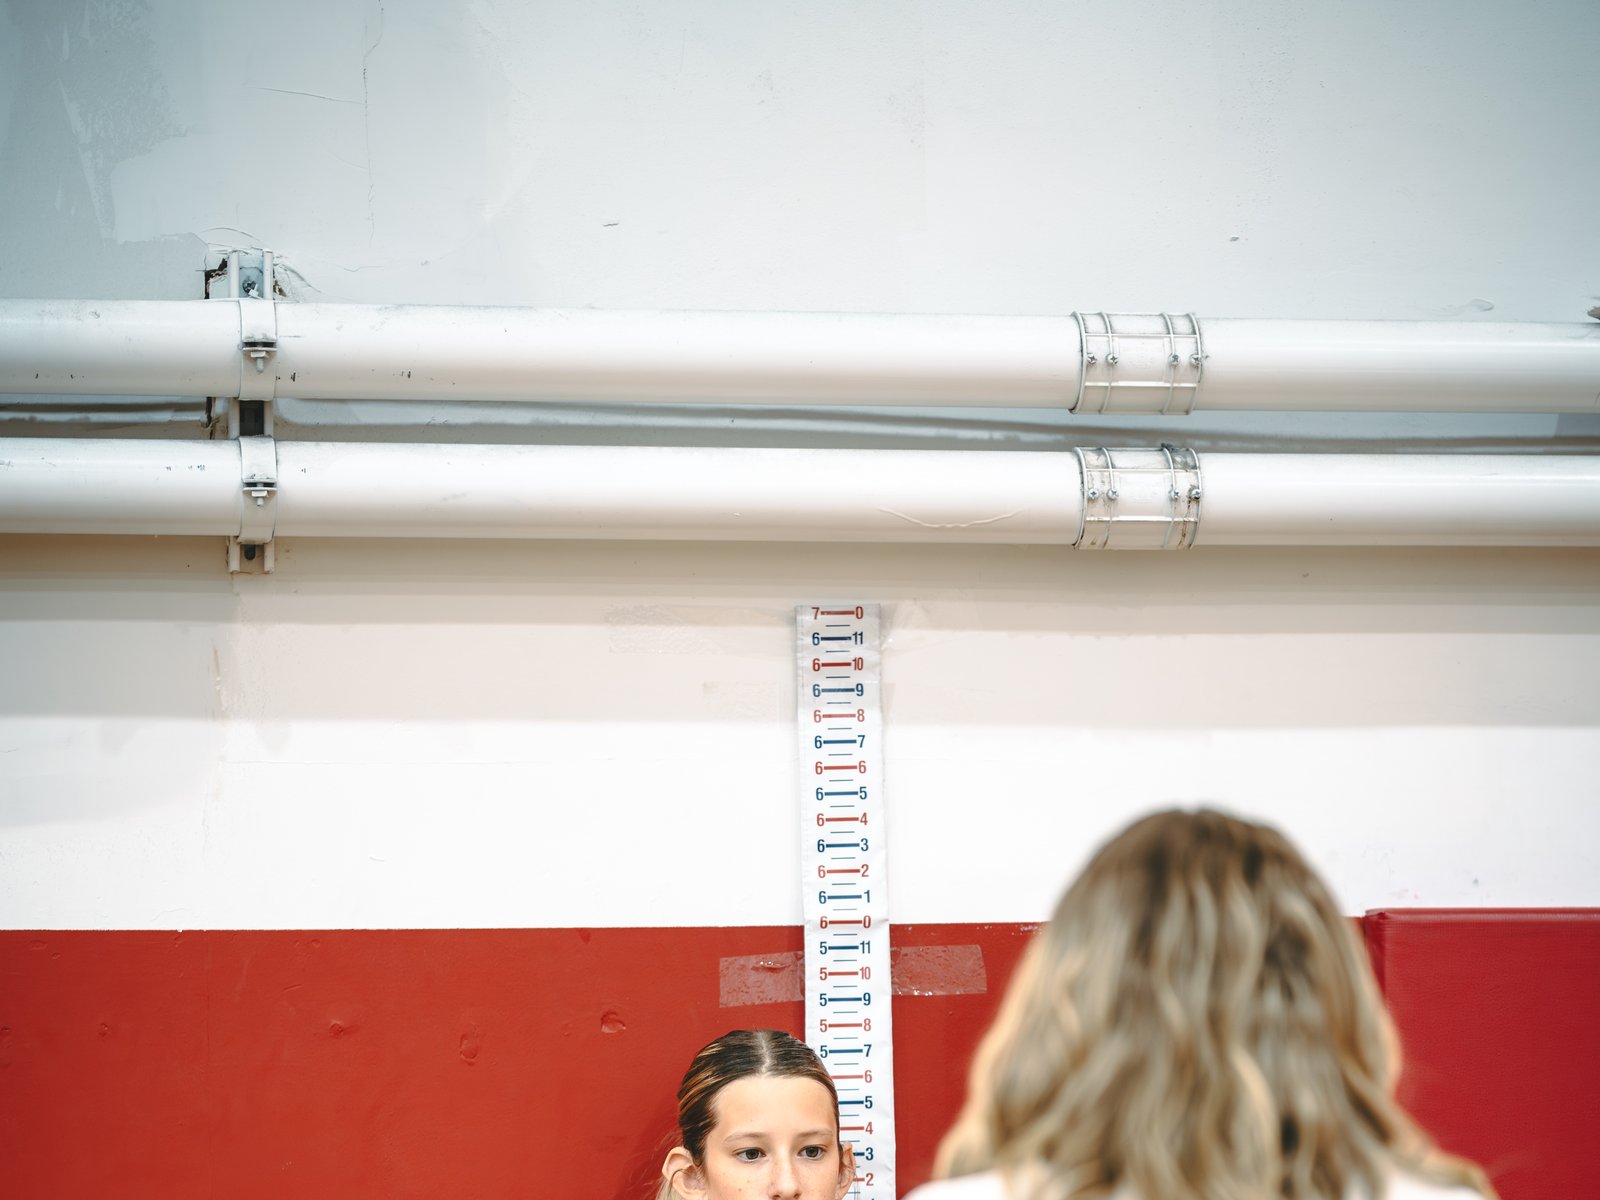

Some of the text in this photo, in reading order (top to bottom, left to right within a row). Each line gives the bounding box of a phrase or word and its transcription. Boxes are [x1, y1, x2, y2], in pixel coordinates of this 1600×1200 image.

[811, 606, 864, 620] 7 0
[812, 631, 864, 646] 6 11
[812, 657, 864, 672] 6 10
[812, 683, 864, 698] 6 9
[813, 708, 865, 723] 6 8
[814, 735, 866, 749] 6 7
[815, 760, 867, 775] 6 6
[815, 786, 867, 801] 6 5
[816, 812, 868, 827] 6 4
[817, 838, 869, 853] 6 3
[818, 864, 869, 878] 6 2
[818, 890, 871, 904] 6 1
[820, 915, 871, 929] 6 0
[819, 940, 871, 955] 5 11
[819, 966, 871, 981] 5 10
[819, 992, 871, 1007] 5 9
[819, 1018, 872, 1032] 5 8
[820, 1044, 872, 1058] 5 7
[864, 1070, 873, 1083] 6
[864, 1096, 873, 1109] 5
[865, 1121, 874, 1135] 4
[865, 1147, 874, 1161] 3
[865, 1173, 874, 1186] 2
